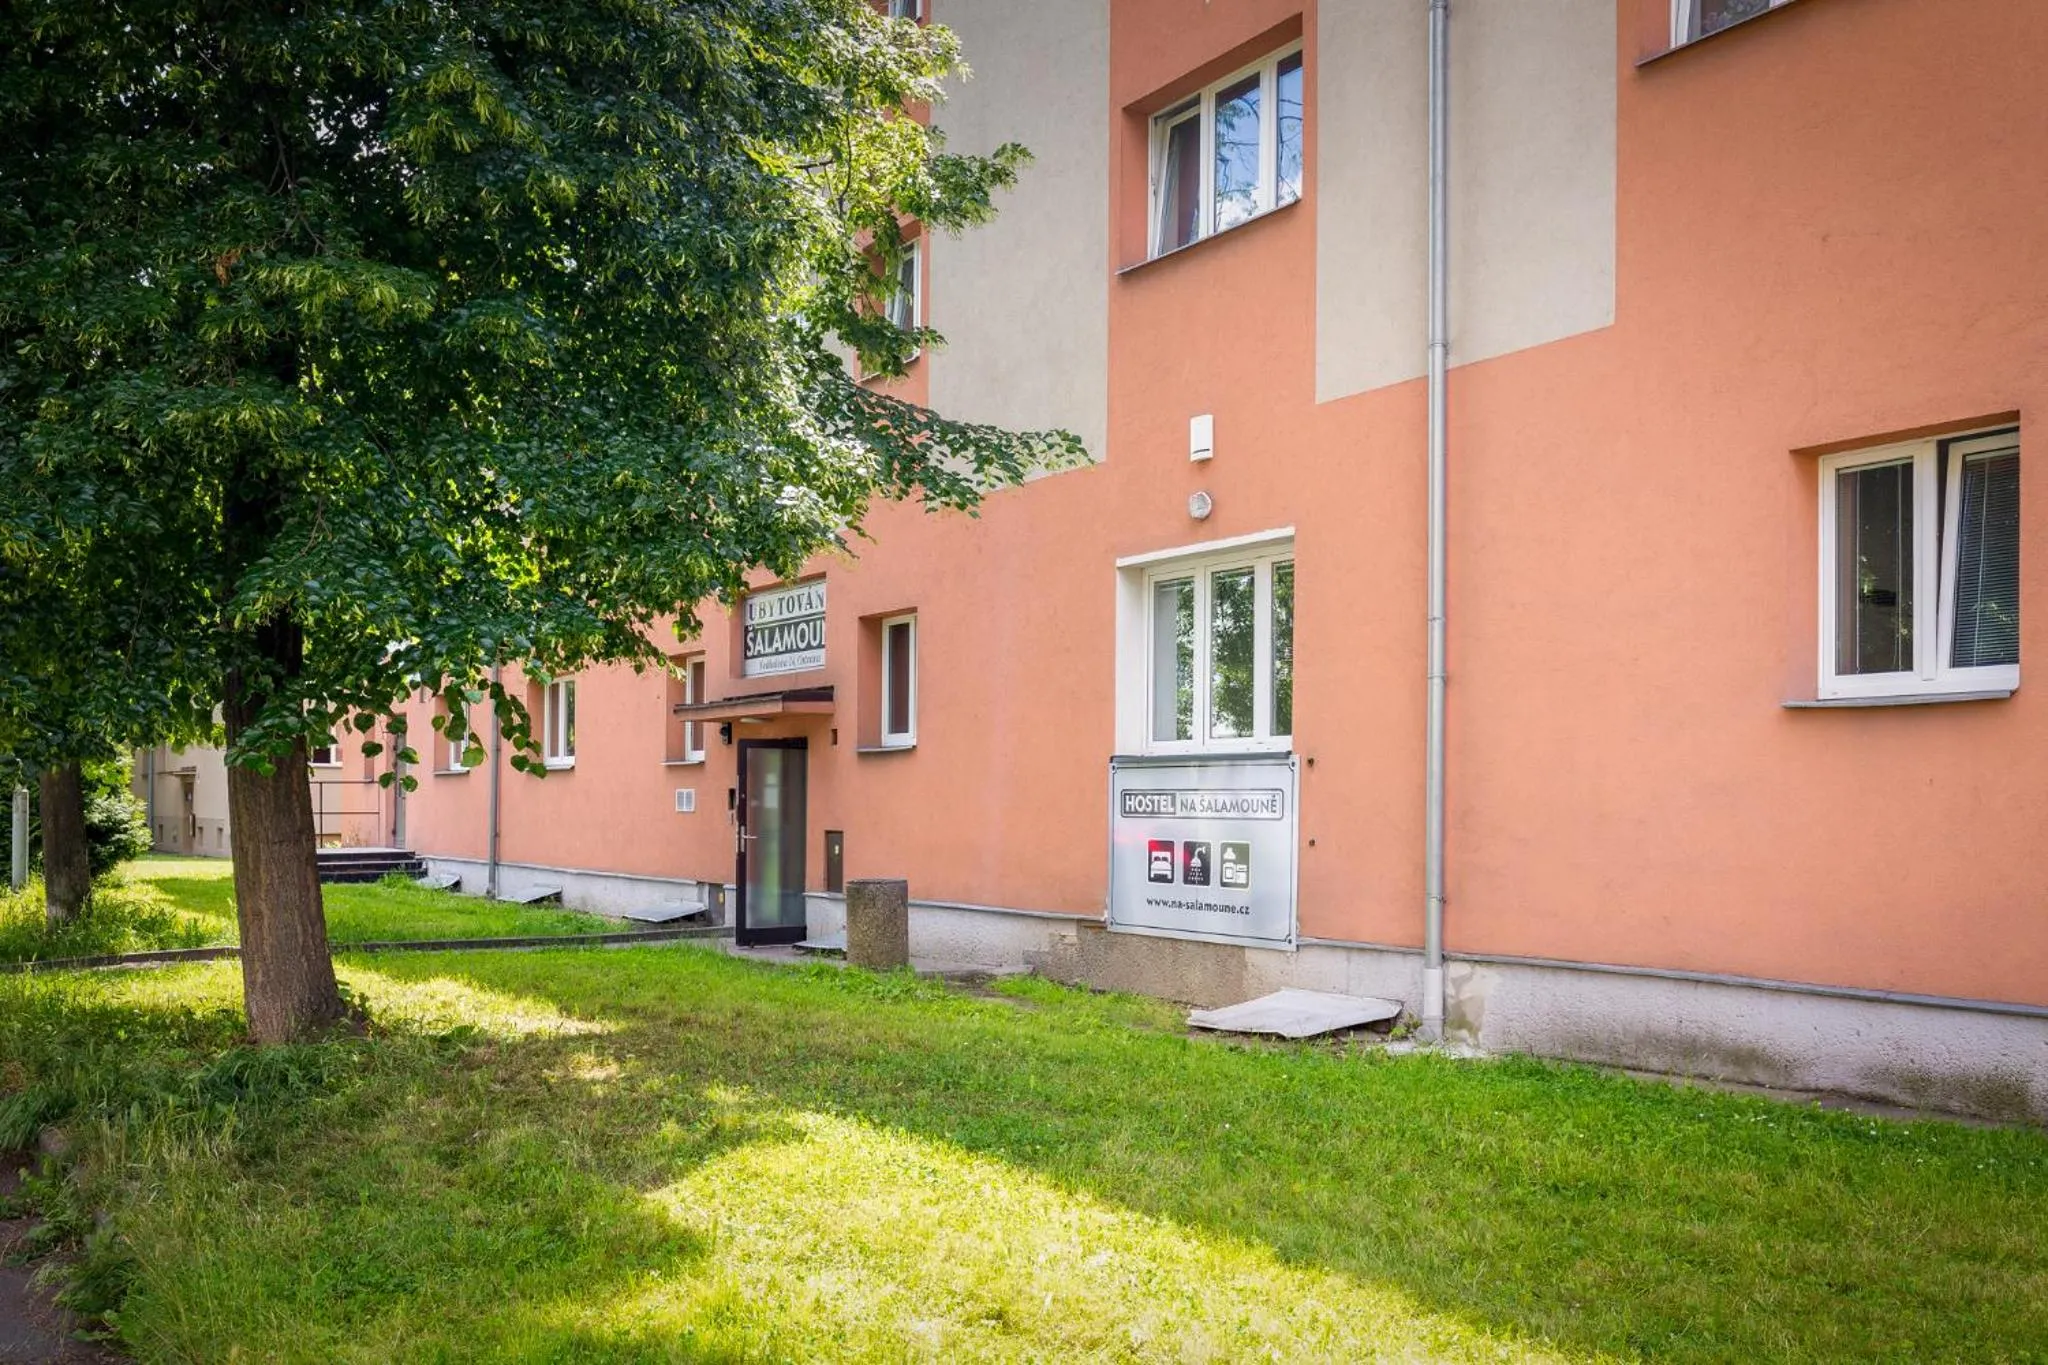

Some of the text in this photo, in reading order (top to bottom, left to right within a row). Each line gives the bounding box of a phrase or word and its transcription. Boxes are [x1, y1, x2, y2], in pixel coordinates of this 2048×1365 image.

[1125, 794, 1174, 814] HOSTEL
[1180, 799, 1196, 813] NA
[1146, 897, 1251, 915] www.na-salamoune.cz
